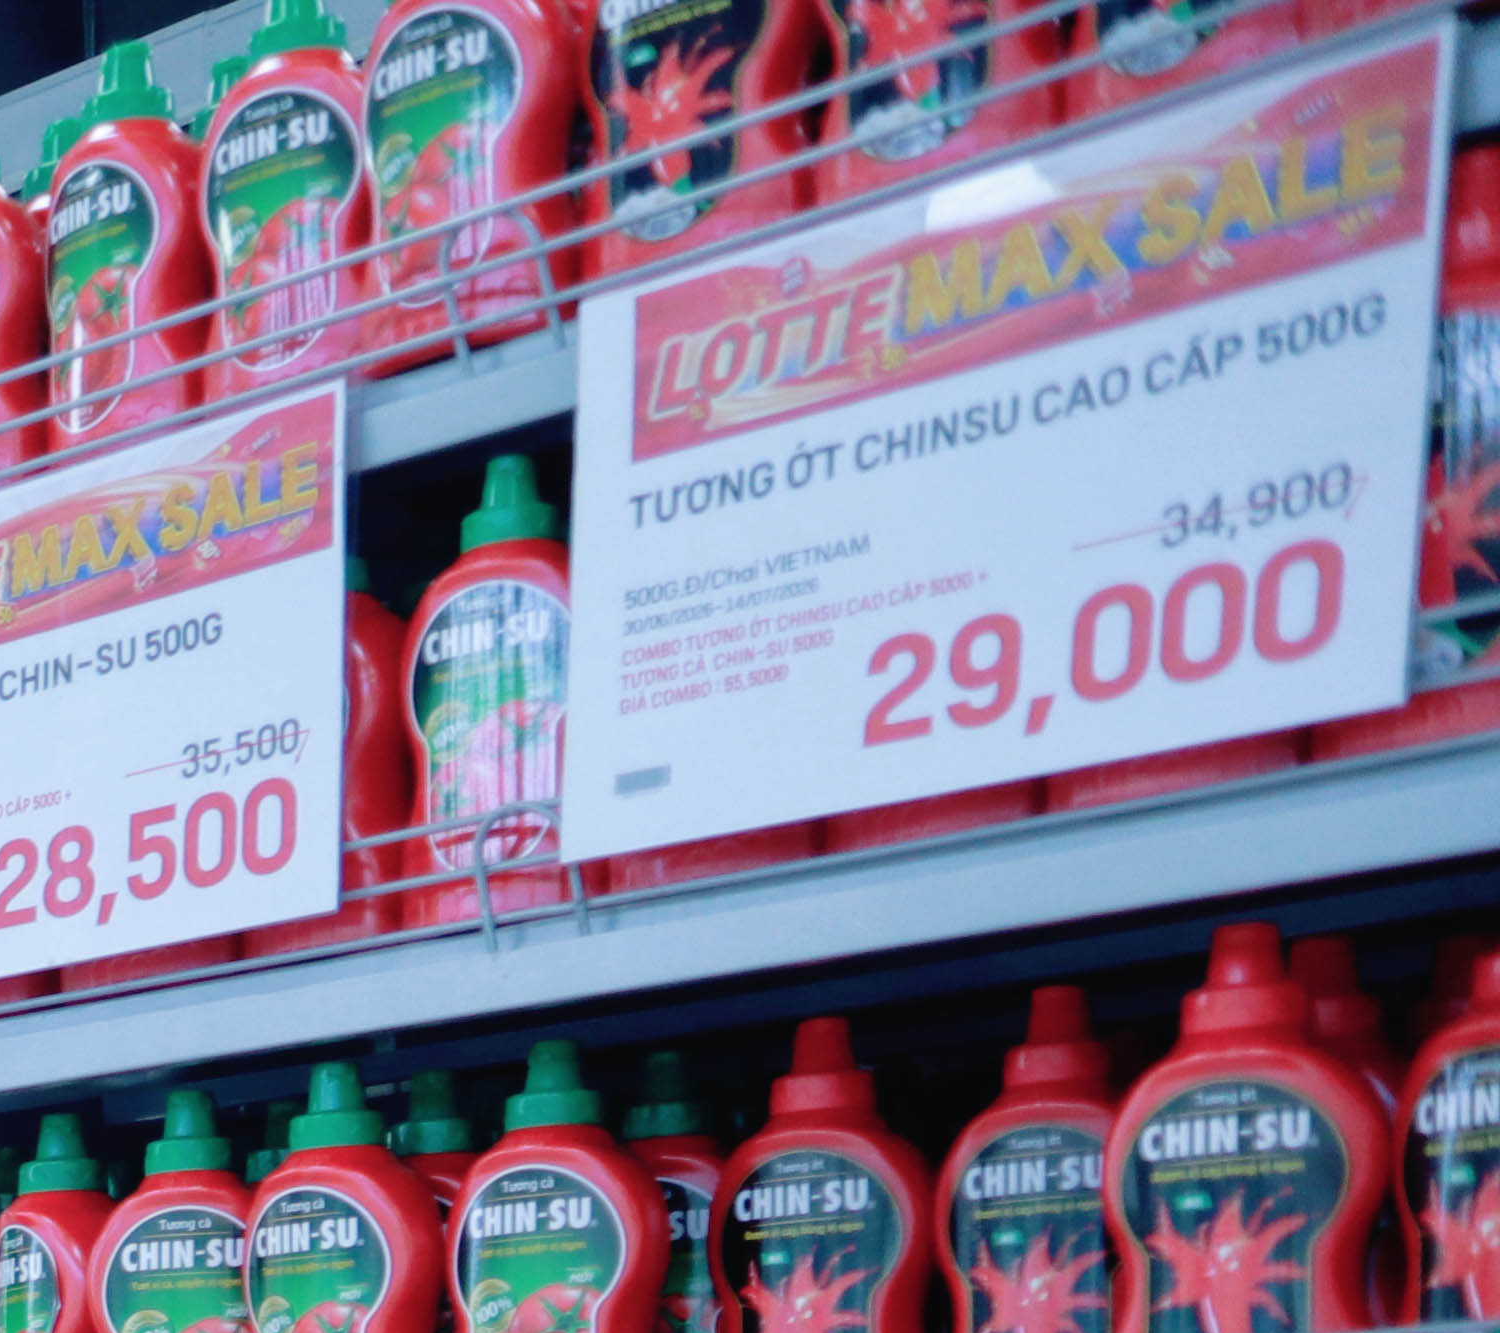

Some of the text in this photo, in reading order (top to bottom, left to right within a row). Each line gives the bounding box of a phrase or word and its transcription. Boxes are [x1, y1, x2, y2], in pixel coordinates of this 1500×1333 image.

[374, 33, 489, 98] CHIN-SU
[215, 109, 332, 172] CHIN-SU
[647, 103, 1408, 422] LOTTE MAX SALE
[629, 293, 1386, 530] TƯƠNG ỚT CHINSU CAO CẤP 500G
[10, 496, 157, 600] MAX
[159, 443, 319, 550] SALE
[1160, 463, 1352, 550] 34,900
[764, 534, 870, 576] VIETNAM
[145, 613, 223, 663] 500G
[863, 538, 1347, 749] 29,000
[181, 718, 300, 780] 35,500
[1140, 1108, 1313, 1160] CHIN-SU
[256, 1217, 360, 1254] CHIN-SU
[469, 1194, 595, 1238] CHIN-SU
